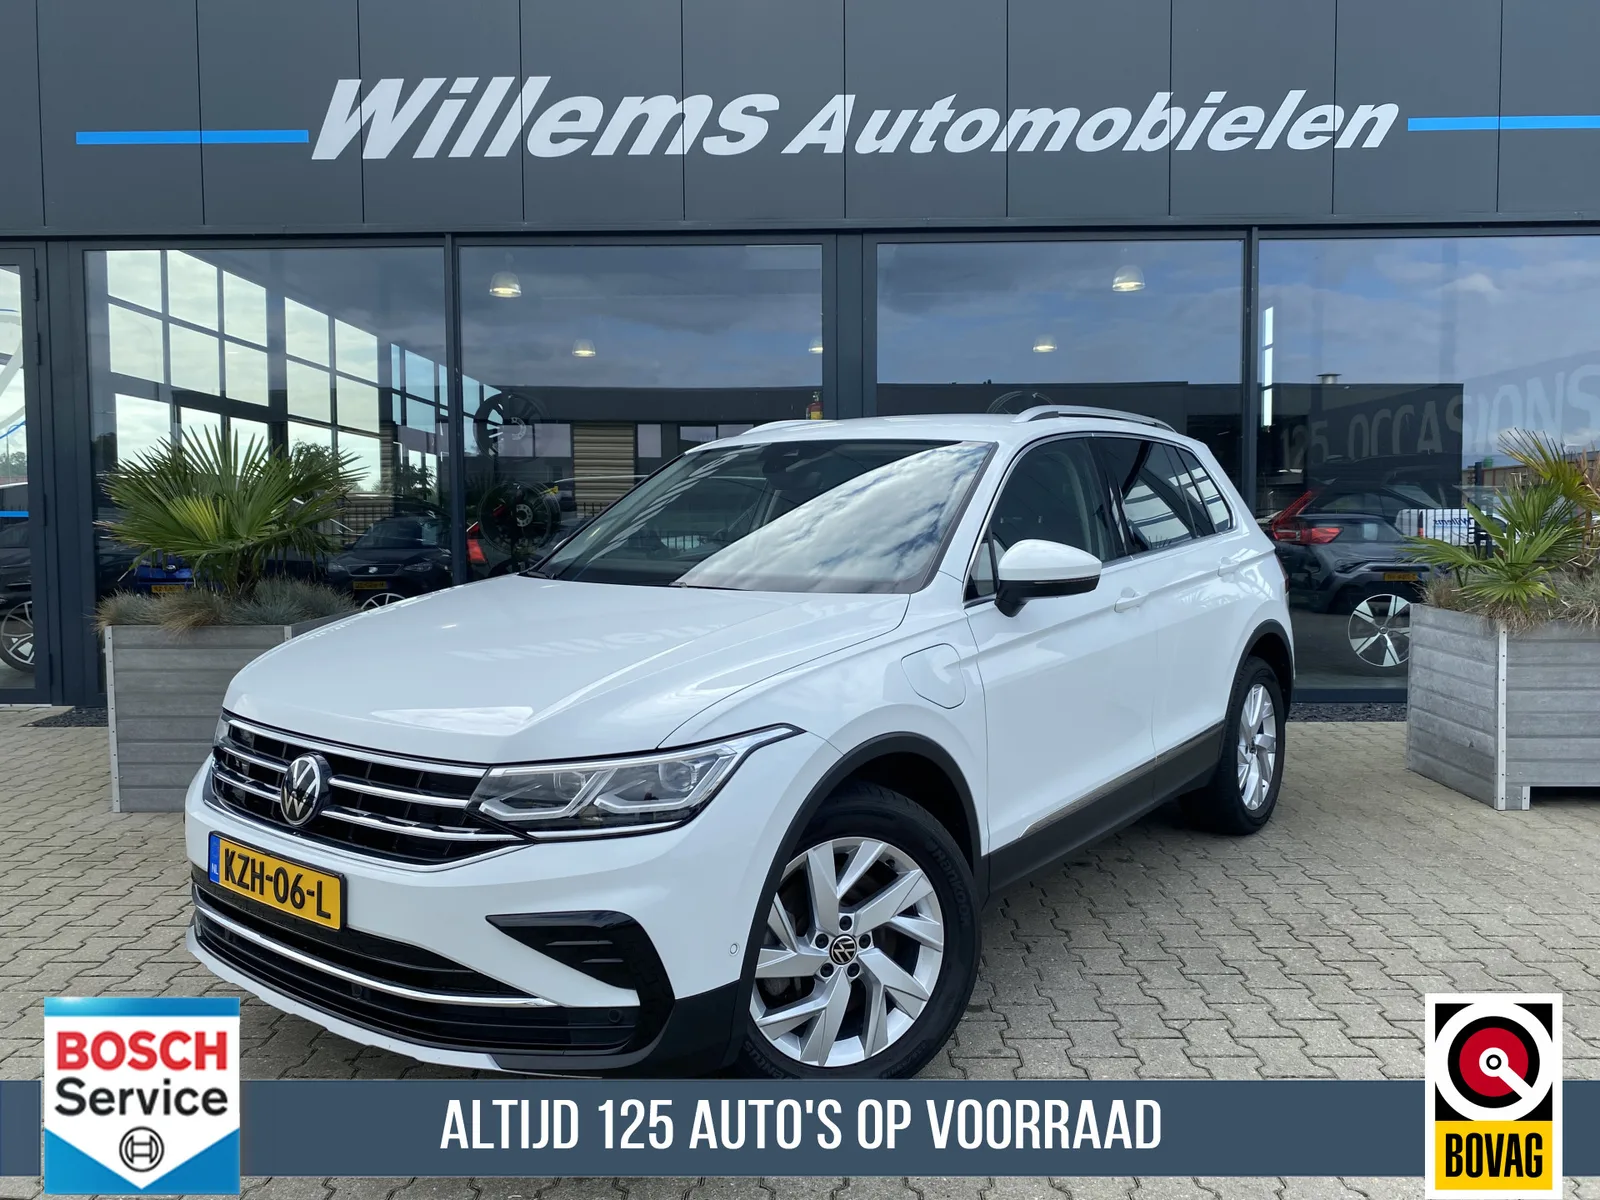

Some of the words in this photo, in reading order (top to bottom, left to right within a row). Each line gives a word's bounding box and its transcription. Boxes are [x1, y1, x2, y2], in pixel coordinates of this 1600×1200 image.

[312, 76, 779, 161] Willems
[782, 89, 1399, 155] Automobielen
[1347, 363, 1600, 460] OCCASIONS
[223, 847, 331, 920] KZH-06-L
